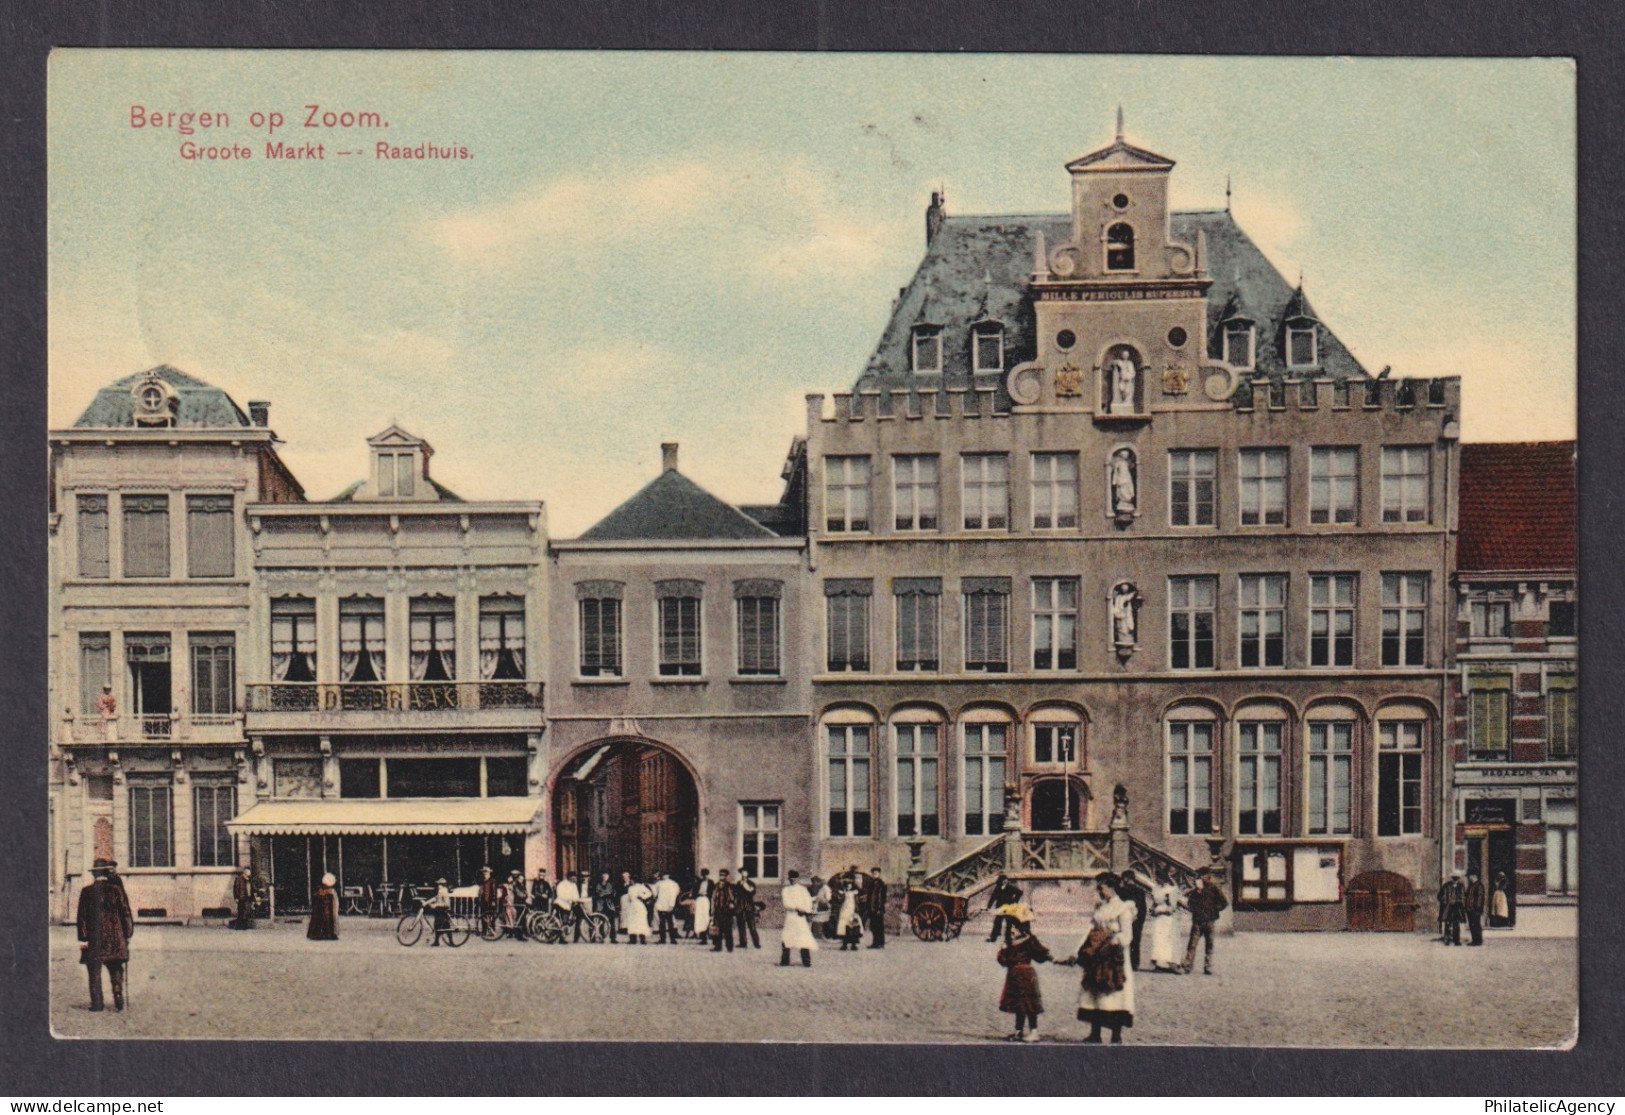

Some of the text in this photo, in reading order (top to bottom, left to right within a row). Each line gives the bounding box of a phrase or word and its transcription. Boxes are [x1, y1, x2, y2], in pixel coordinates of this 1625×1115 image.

[130, 104, 389, 135] Bergen op Zoom.
[180, 141, 252, 160] Groote
[265, 141, 325, 160] Markt
[376, 141, 474, 160] Raadhuis.
[324, 685, 457, 710] DE DRAAK
